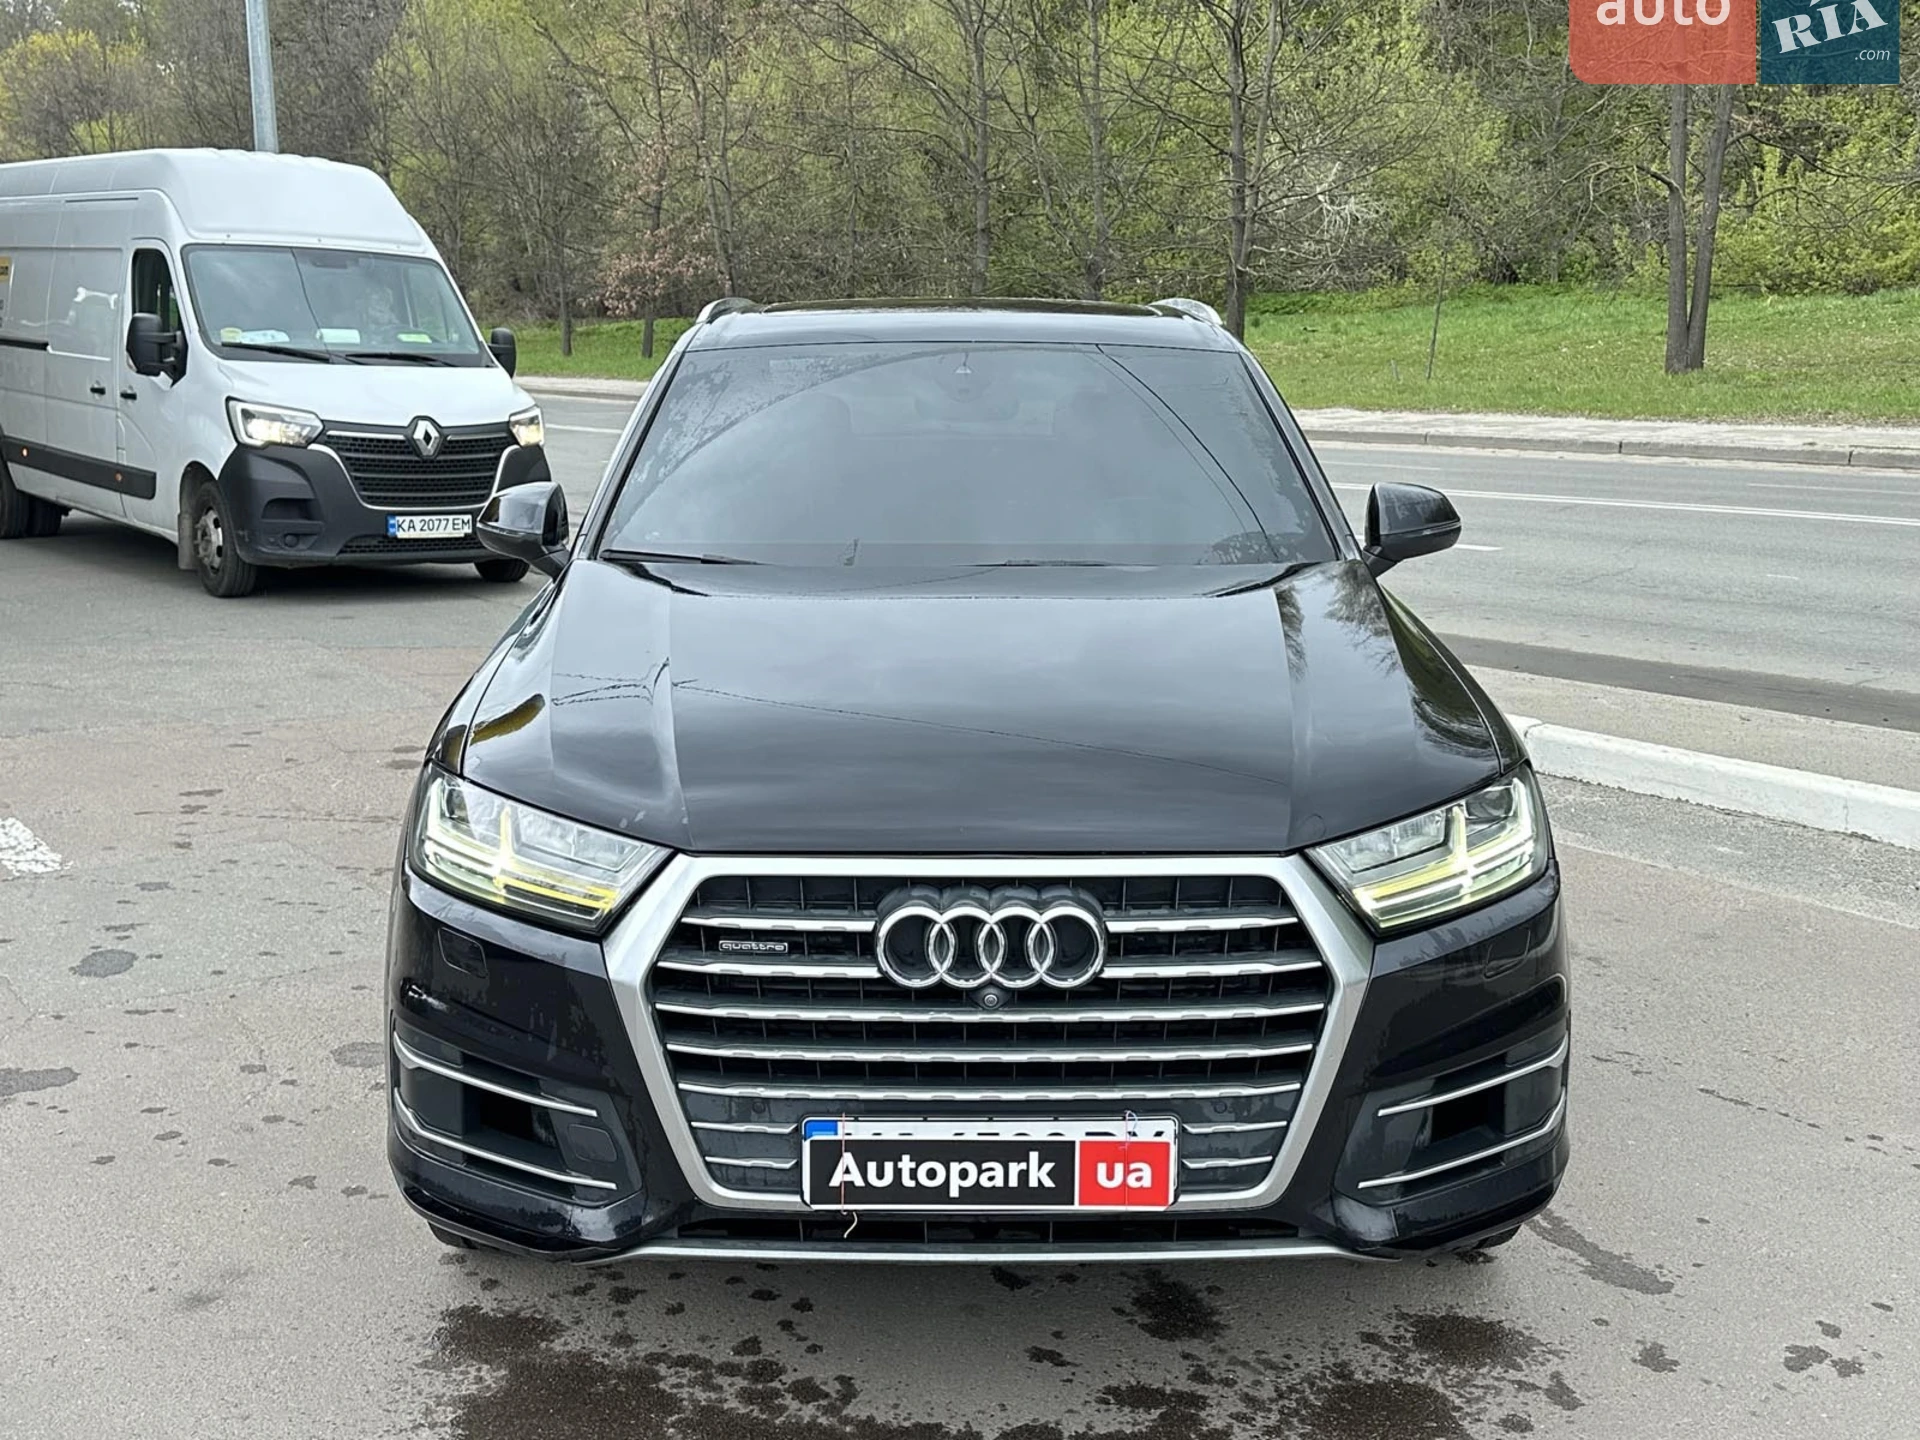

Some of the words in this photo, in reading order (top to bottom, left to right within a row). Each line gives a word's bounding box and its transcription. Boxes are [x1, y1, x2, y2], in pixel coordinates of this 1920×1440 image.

[722, 942, 785, 951] quattro
[828, 1150, 1056, 1198] Autopark
[1096, 1161, 1152, 1188] ua
